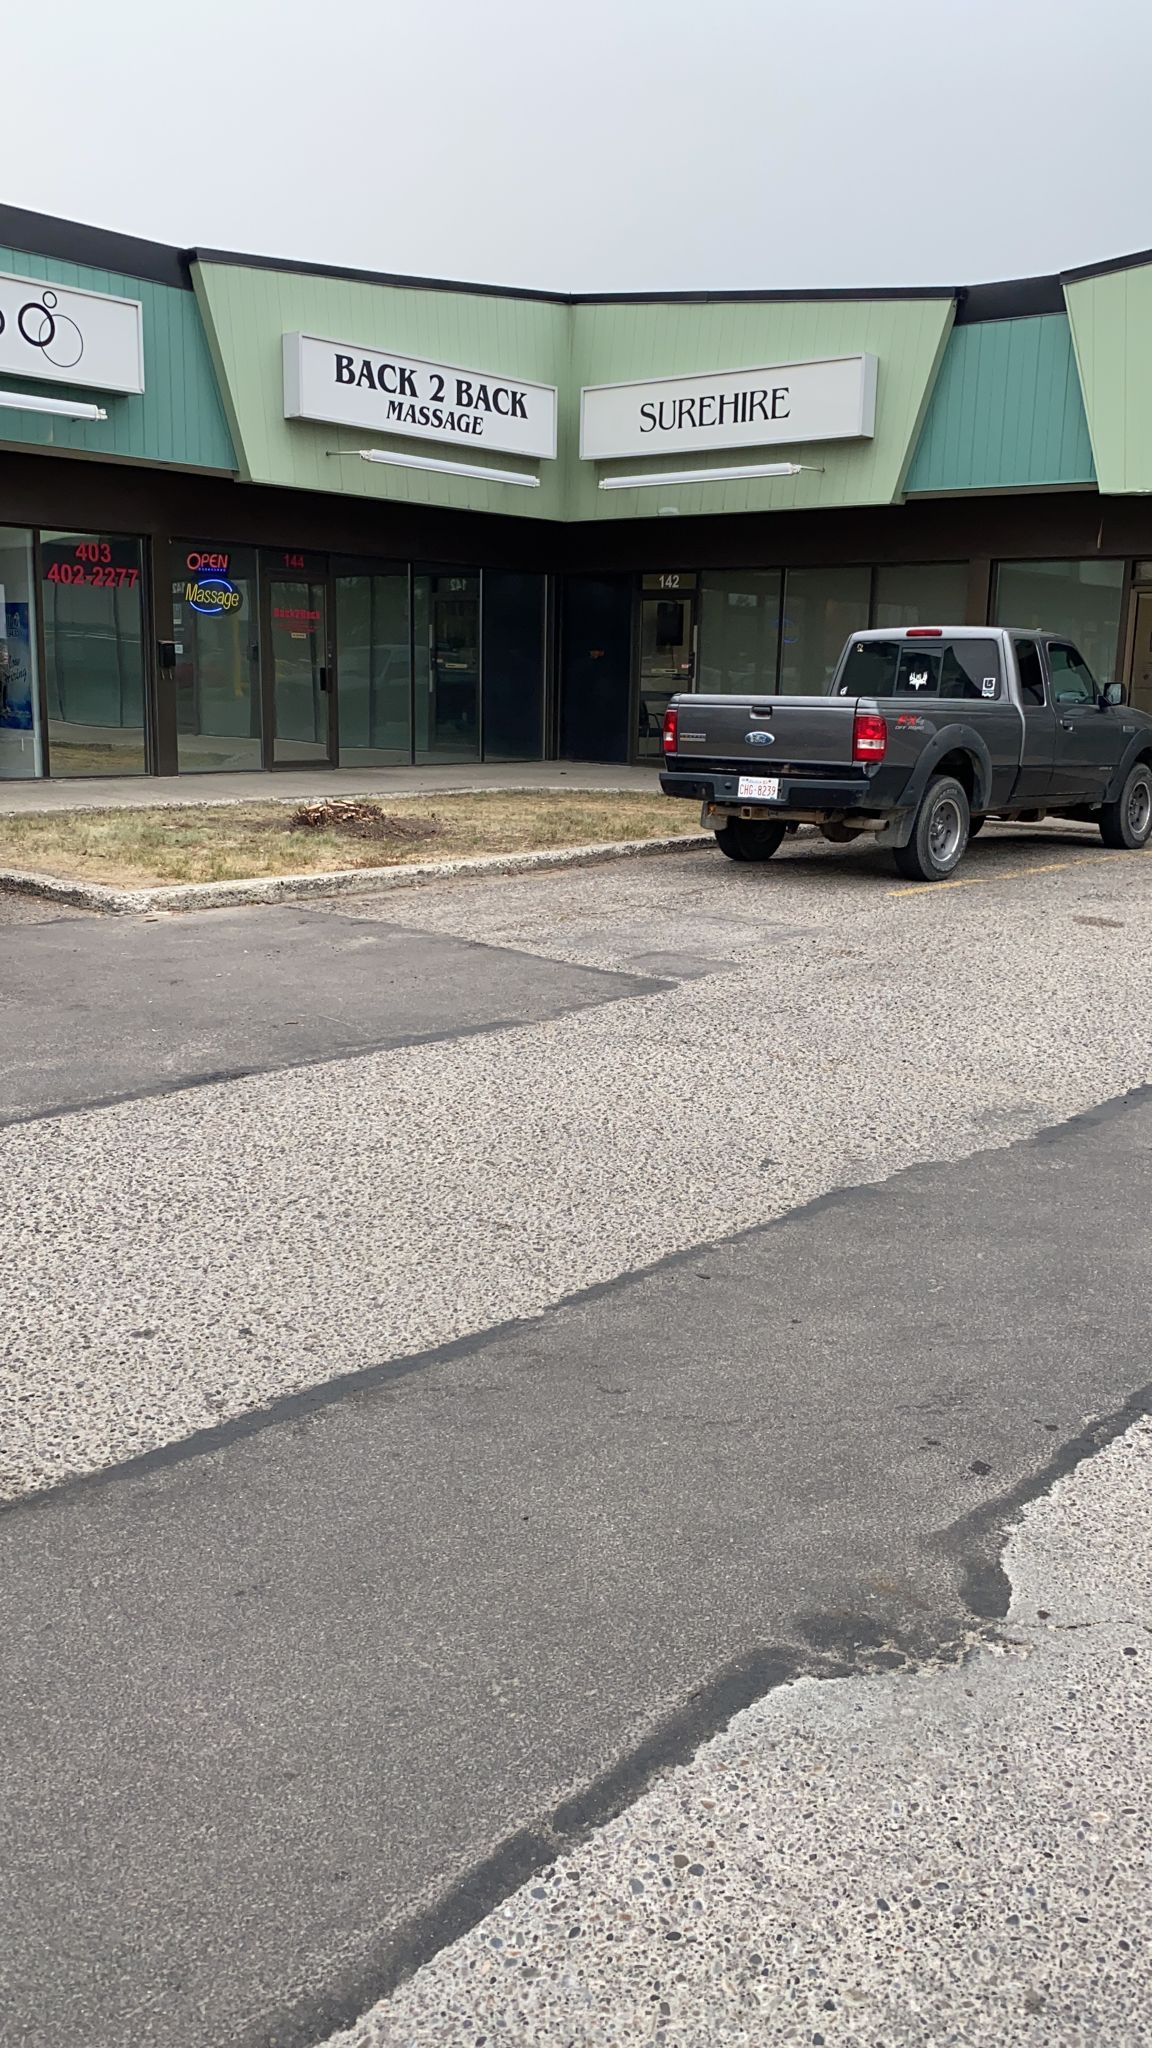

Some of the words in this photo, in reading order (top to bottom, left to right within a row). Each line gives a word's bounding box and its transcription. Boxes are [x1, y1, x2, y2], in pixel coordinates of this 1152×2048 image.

[334, 353, 419, 398] BACK
[429, 374, 446, 403] 2
[455, 379, 528, 419] BACK
[386, 400, 484, 436] MASSAGE
[639, 387, 791, 433] SUREHIRE
[75, 543, 112, 563] 403
[186, 552, 229, 570] OPEN
[47, 563, 139, 589] 402-2277
[659, 575, 680, 588] 142
[185, 583, 240, 610] Massage
